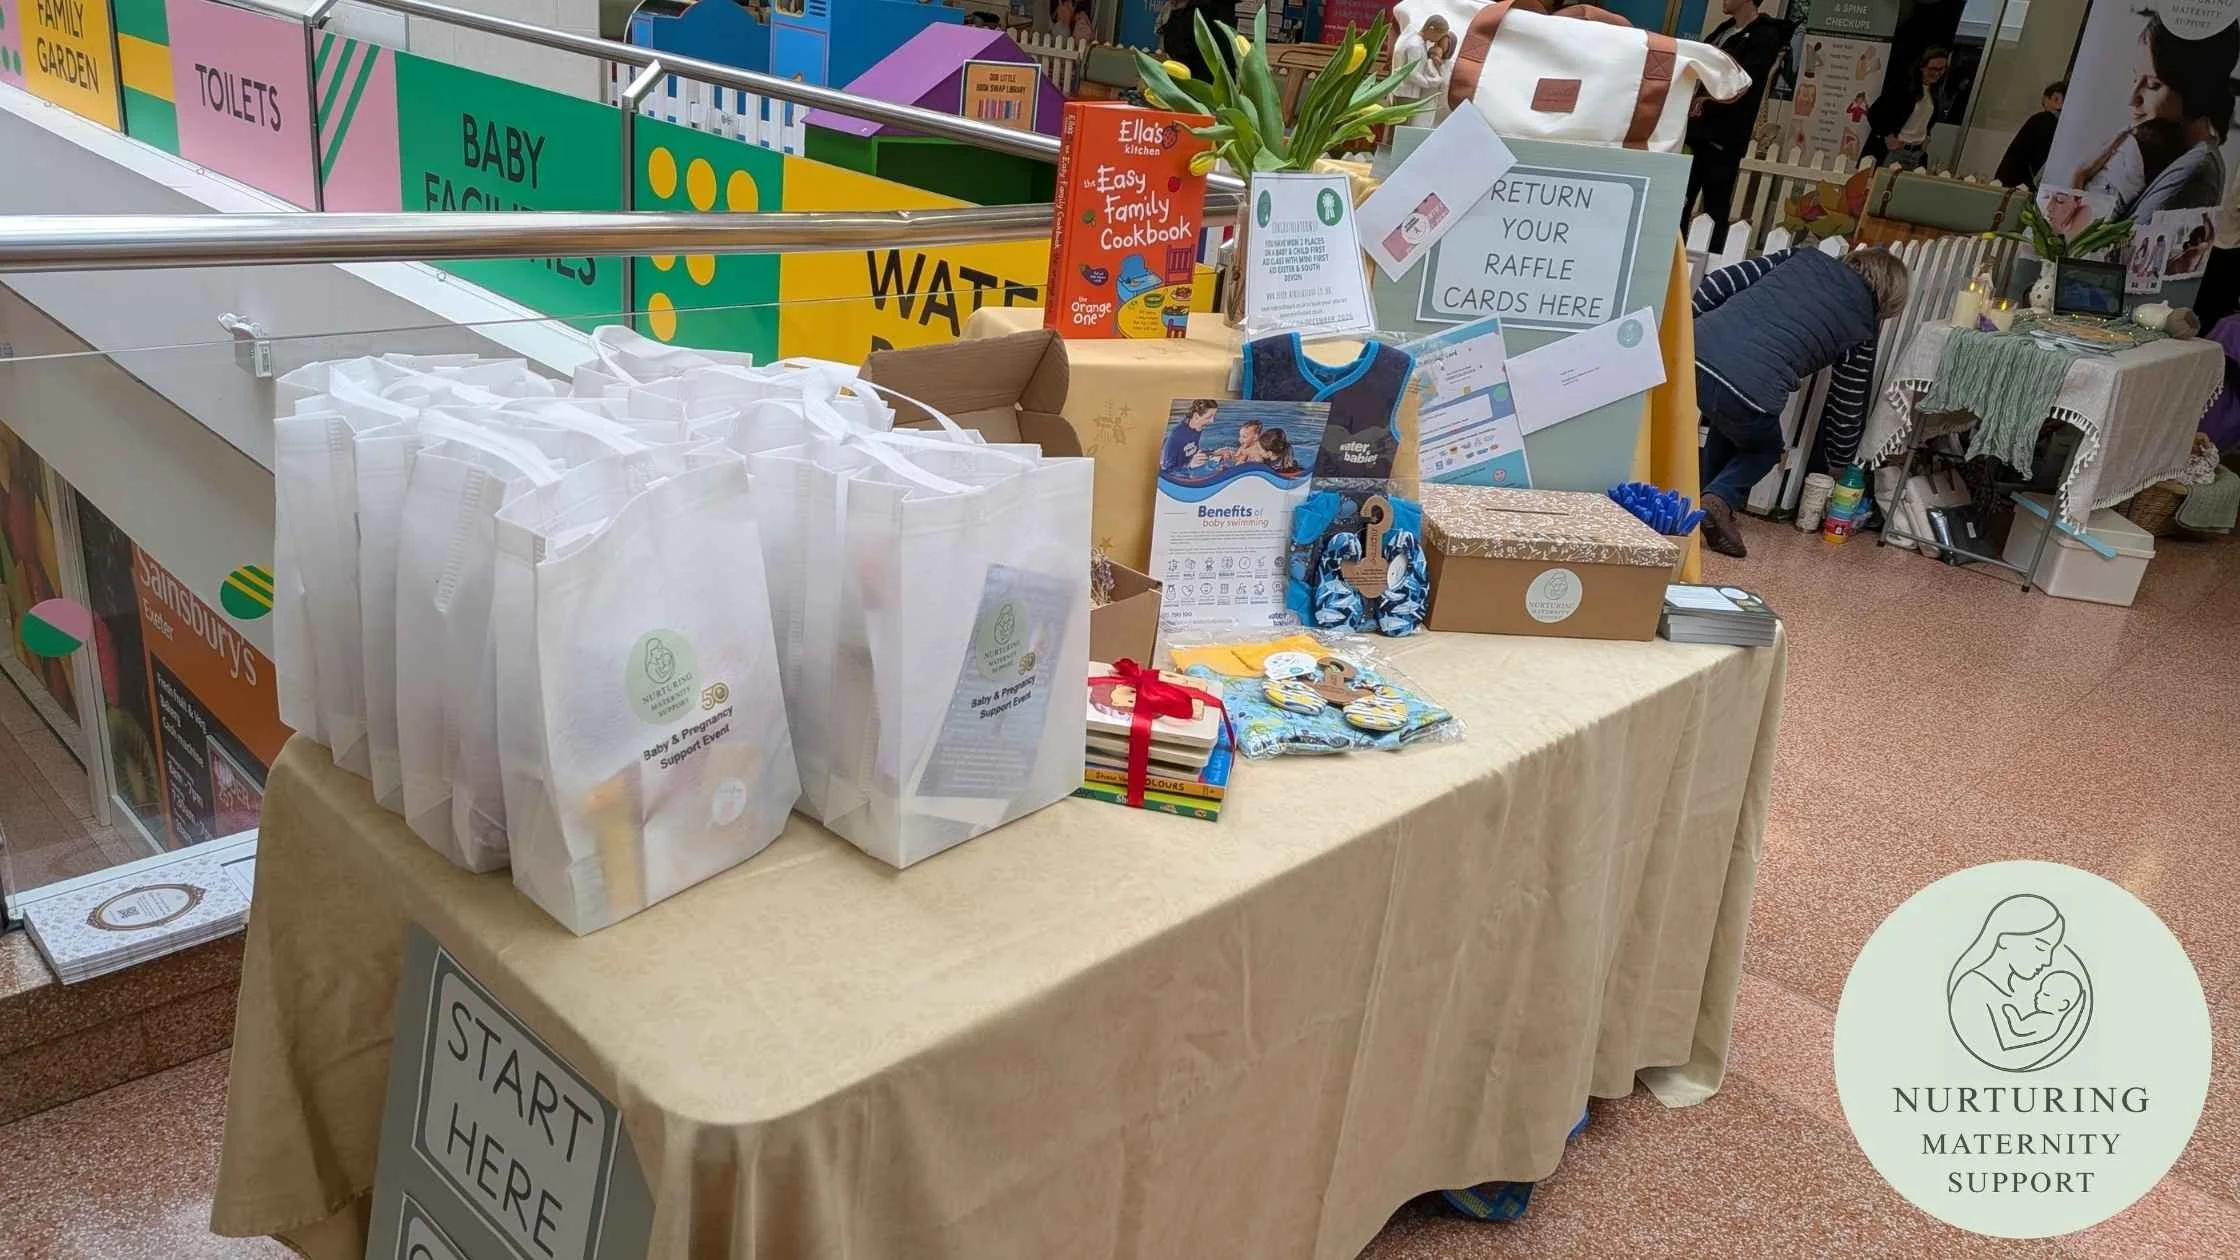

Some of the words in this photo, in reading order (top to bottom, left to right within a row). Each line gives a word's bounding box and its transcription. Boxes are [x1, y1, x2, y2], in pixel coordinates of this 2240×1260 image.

[37, 0, 84, 39] FAMILY
[1825, 17, 1871, 29] CHECKUPS
[1843, 3, 1869, 15] SPINE
[37, 37, 100, 94] GARDEN
[195, 63, 282, 132] TOILETS
[990, 84, 1006, 93] SWAP
[1006, 85, 1026, 94] LIBRARY
[1118, 119, 1164, 144] Ella's
[462, 112, 546, 189] BABY
[1125, 145, 1161, 156] kitchen
[1083, 179, 1097, 189] the
[1096, 164, 1146, 194] Easy
[1104, 190, 1170, 224] Family
[1490, 179, 1594, 209] RETURN
[1100, 215, 1192, 250] Cookbook
[1304, 236, 1326, 246] PLACES
[1502, 217, 1569, 244] YOUR
[1285, 255, 1298, 264] WITH
[1313, 254, 1329, 263] FIRST
[1293, 246, 1310, 255] CHILD
[1310, 245, 1326, 254] FIRST
[1284, 273, 1303, 282] DEVON
[1301, 264, 1321, 273] SOUTH
[1484, 253, 1575, 280] RAFFLE
[1071, 301, 1112, 317] Orange
[1444, 286, 1529, 313] CARDS
[1538, 293, 1603, 318] HERE
[1073, 313, 1098, 325] One
[1198, 505, 1253, 518] Benefits
[1254, 507, 1264, 517] of
[1202, 518, 1225, 528] baby
[1226, 518, 1269, 528] swimming
[136, 545, 257, 687] Sainsbury's
[143, 598, 174, 640] Exeter
[642, 672, 693, 704] NURTURING
[651, 686, 691, 711] MATERNITY
[702, 682, 729, 710] 50
[971, 695, 992, 708] Baby
[993, 690, 1000, 701] &
[1001, 675, 1036, 697] Pregnancy
[979, 700, 1012, 719] Support
[1013, 690, 1032, 706] Event
[643, 741, 670, 761] Baby
[671, 734, 680, 745] &
[681, 706, 734, 740] Pregnancy
[660, 741, 702, 769] Support
[702, 724, 730, 746] Event
[447, 1001, 594, 1162] START
[447, 1102, 563, 1258] HERE
